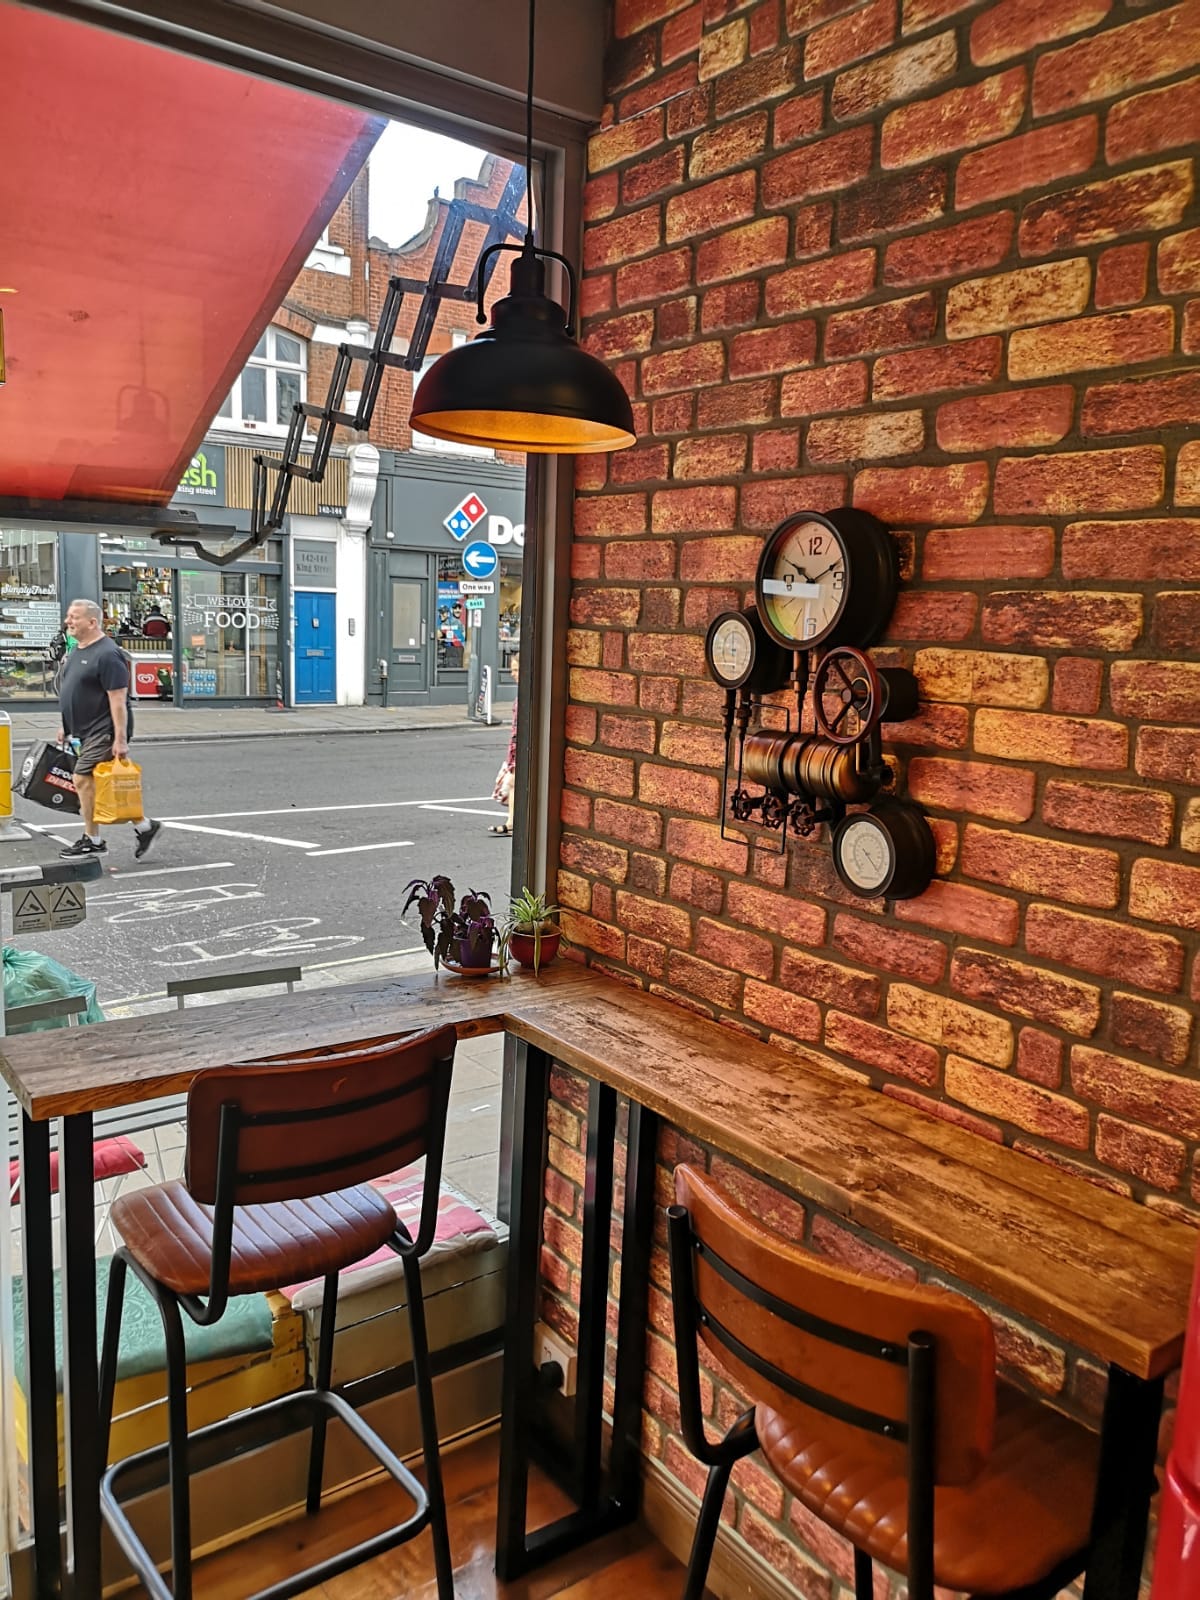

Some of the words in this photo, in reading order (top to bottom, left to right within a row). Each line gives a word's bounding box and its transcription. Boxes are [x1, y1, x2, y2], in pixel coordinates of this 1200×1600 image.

[195, 487, 217, 496] street
[808, 537, 822, 555] 12
[296, 562, 312, 573] King
[314, 563, 329, 573] Stree
[783, 574, 794, 591] 9
[833, 571, 843, 590] 3
[207, 597, 225, 606] WE
[226, 597, 254, 607] LOVE
[203, 611, 260, 629] FOOD
[806, 618, 817, 636] 6
